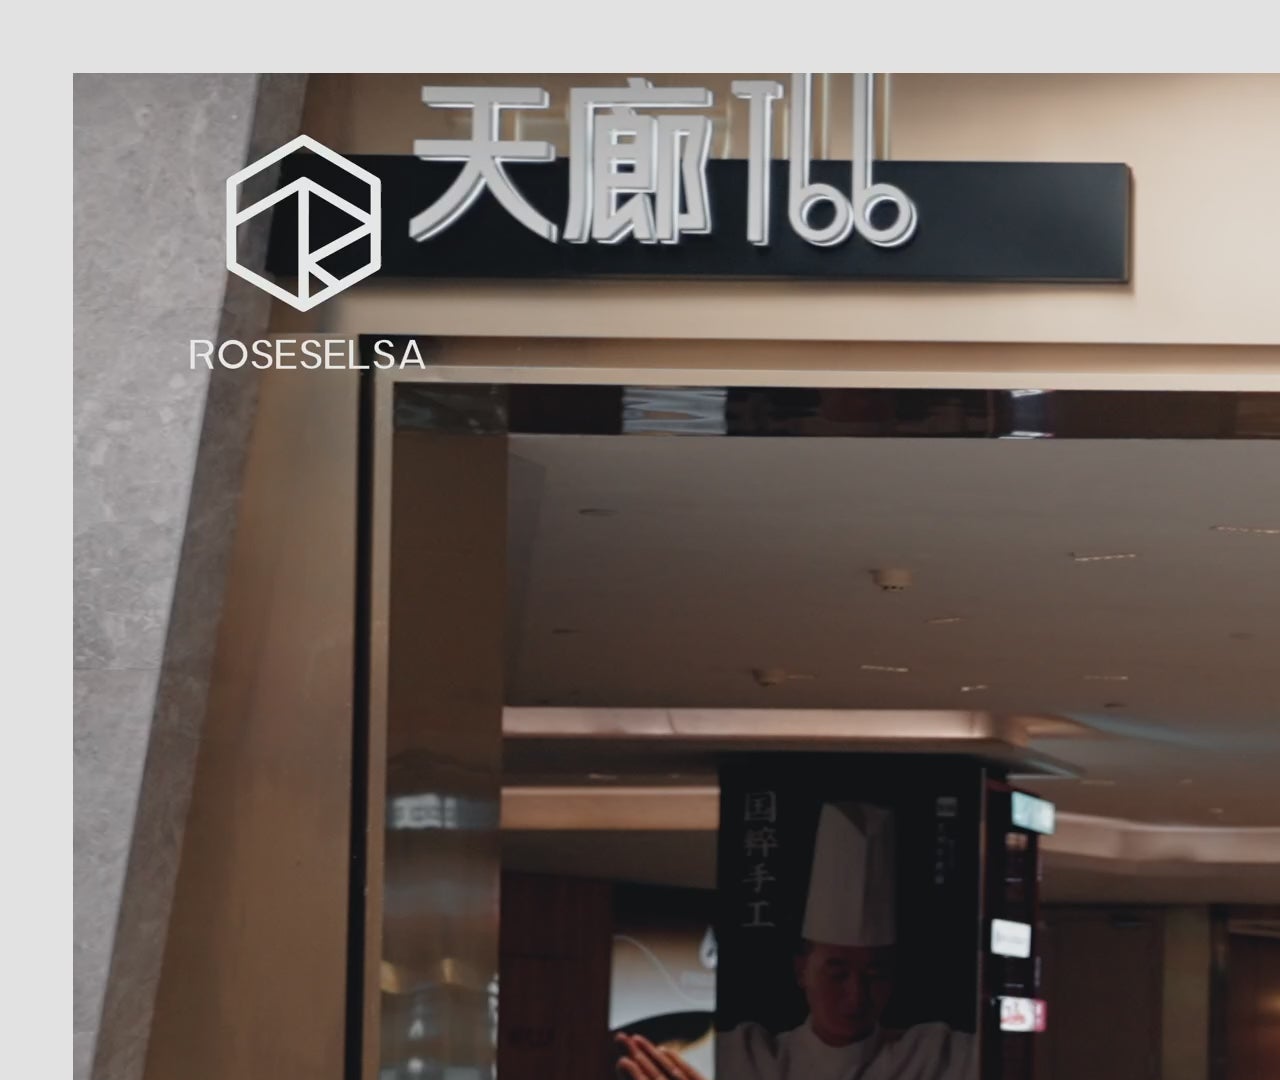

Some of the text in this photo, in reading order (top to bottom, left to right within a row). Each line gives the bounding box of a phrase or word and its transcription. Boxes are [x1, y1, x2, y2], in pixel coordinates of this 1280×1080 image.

[409, 78, 711, 245] 天廊
[740, 791, 779, 928] 国粹手工
